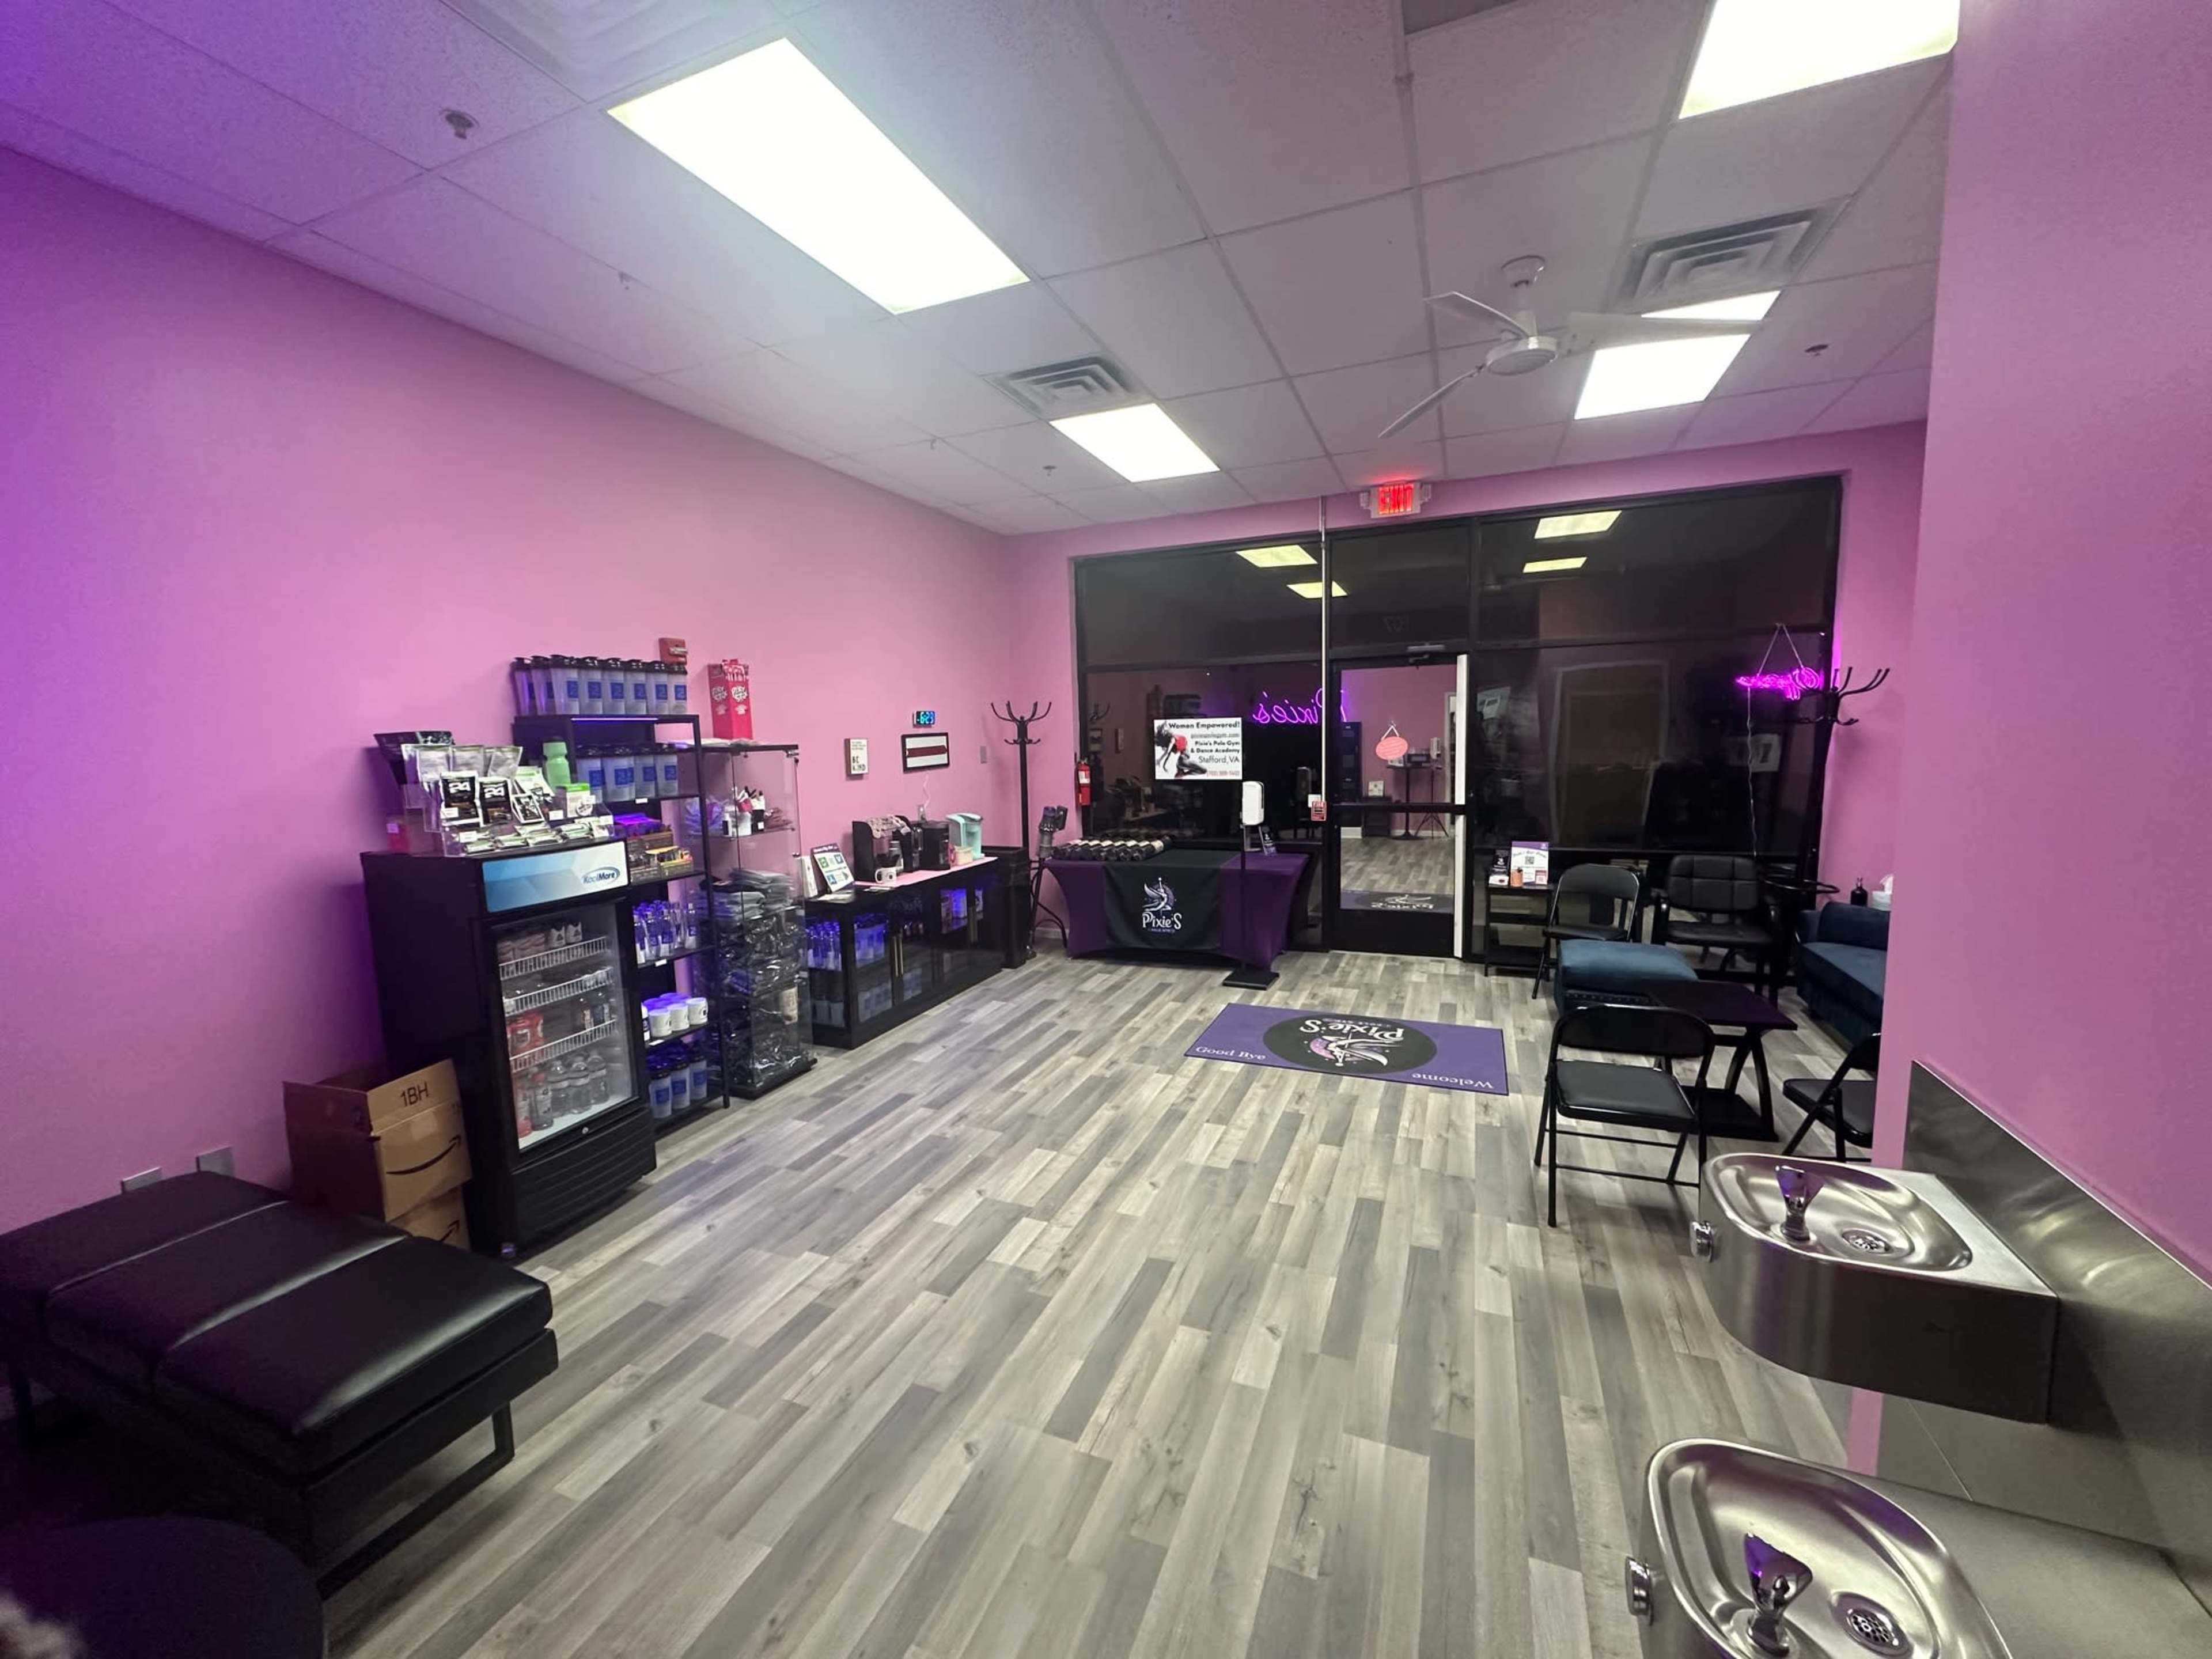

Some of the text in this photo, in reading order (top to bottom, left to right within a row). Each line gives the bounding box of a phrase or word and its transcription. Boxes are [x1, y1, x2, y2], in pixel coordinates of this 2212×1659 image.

[1196, 721, 1240, 730] Empowered!
[1196, 1046, 1266, 1060] Good Bye
[1412, 1072, 1494, 1089] Welcome
[400, 1080, 429, 1107] 1BH
